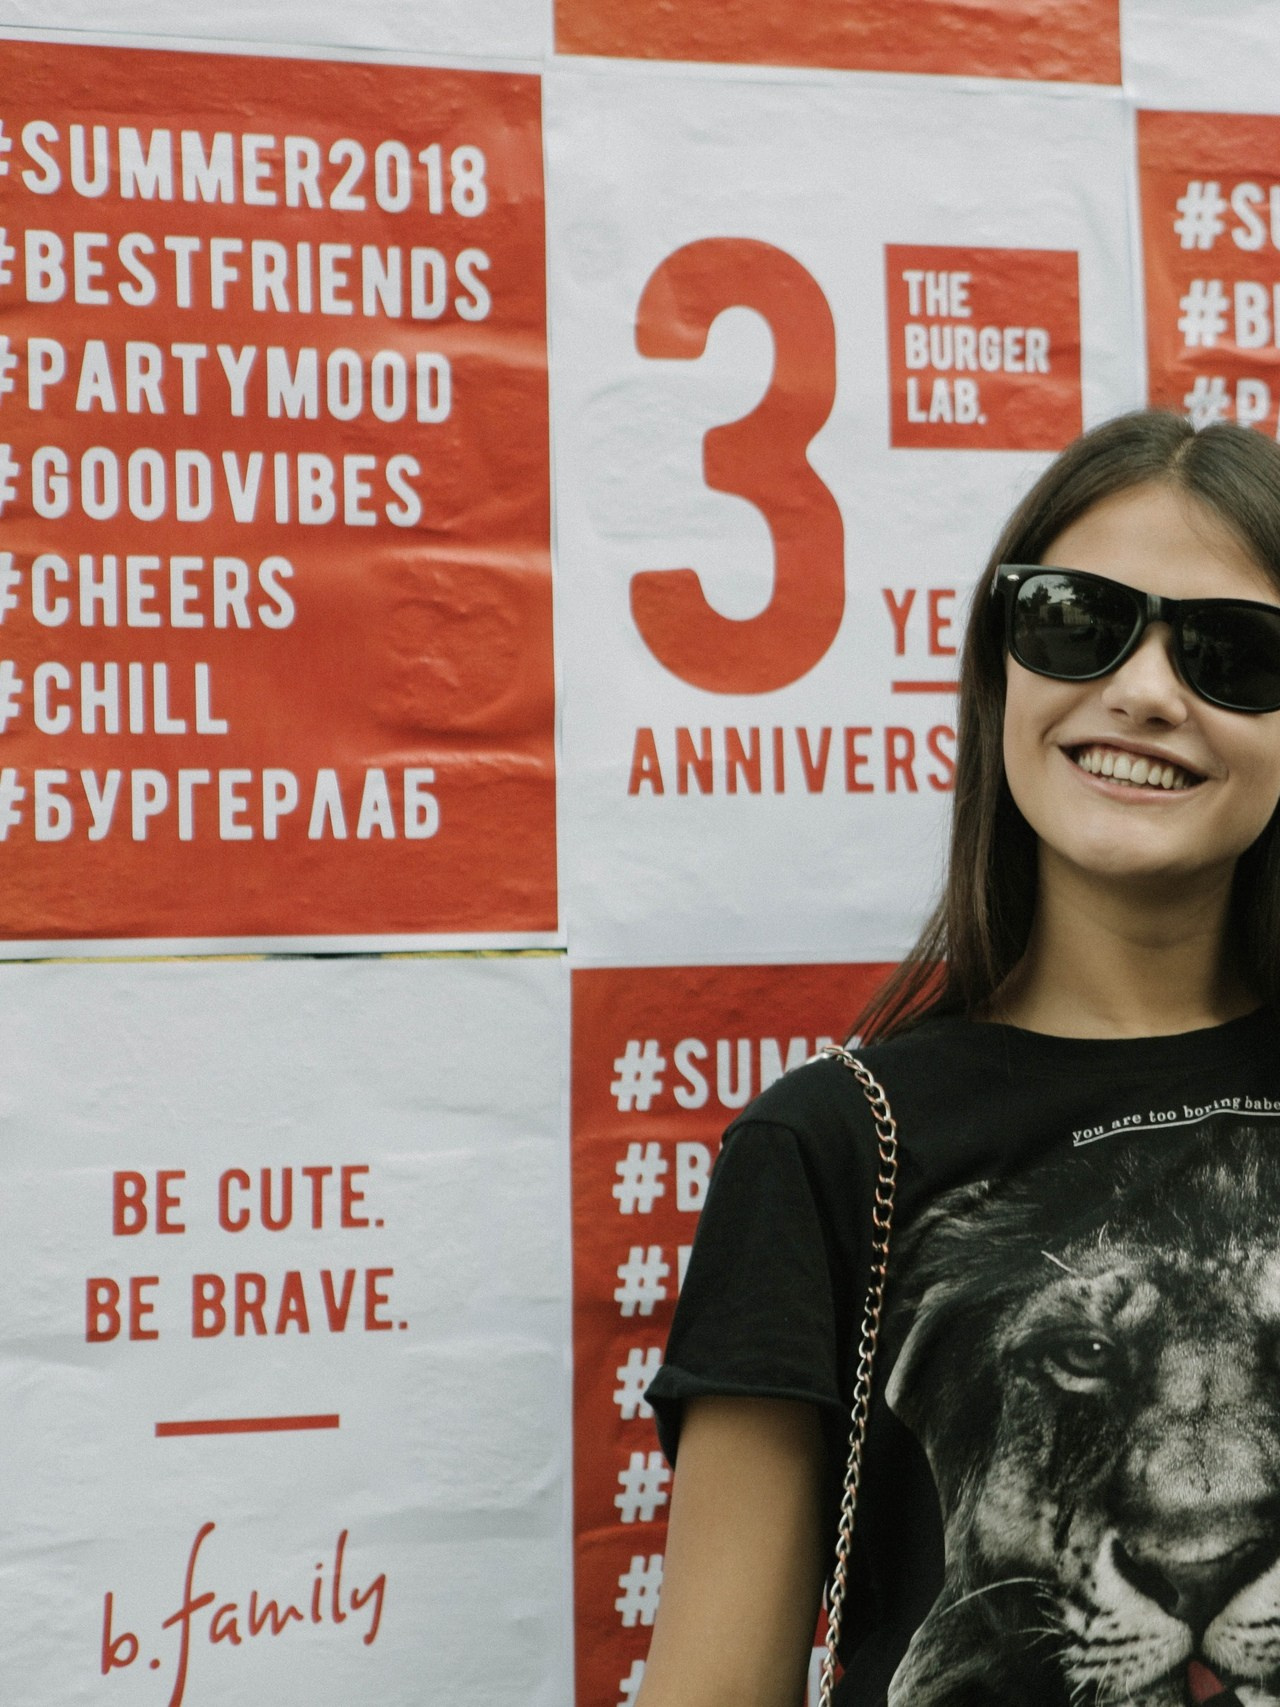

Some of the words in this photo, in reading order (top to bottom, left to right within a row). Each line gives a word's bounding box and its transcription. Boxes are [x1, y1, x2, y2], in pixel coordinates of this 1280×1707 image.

[0, 119, 488, 218] SUMMER2018
[0, 227, 491, 321] BESTFRIENDS
[902, 270, 972, 318] THE
[904, 323, 1050, 374] BURGER
[906, 377, 987, 425] LAB.
[629, 236, 847, 697] 3
[628, 724, 958, 796] ANNIVERS
[1072, 1126, 1104, 1143] you
[1111, 1114, 1142, 1129] are
[1149, 1110, 1177, 1122] too
[1183, 1097, 1241, 1119] boring
[113, 1169, 187, 1237] BE
[219, 1164, 385, 1233] CUTE.
[87, 1275, 161, 1343] BE
[192, 1267, 409, 1339] BRAVE.
